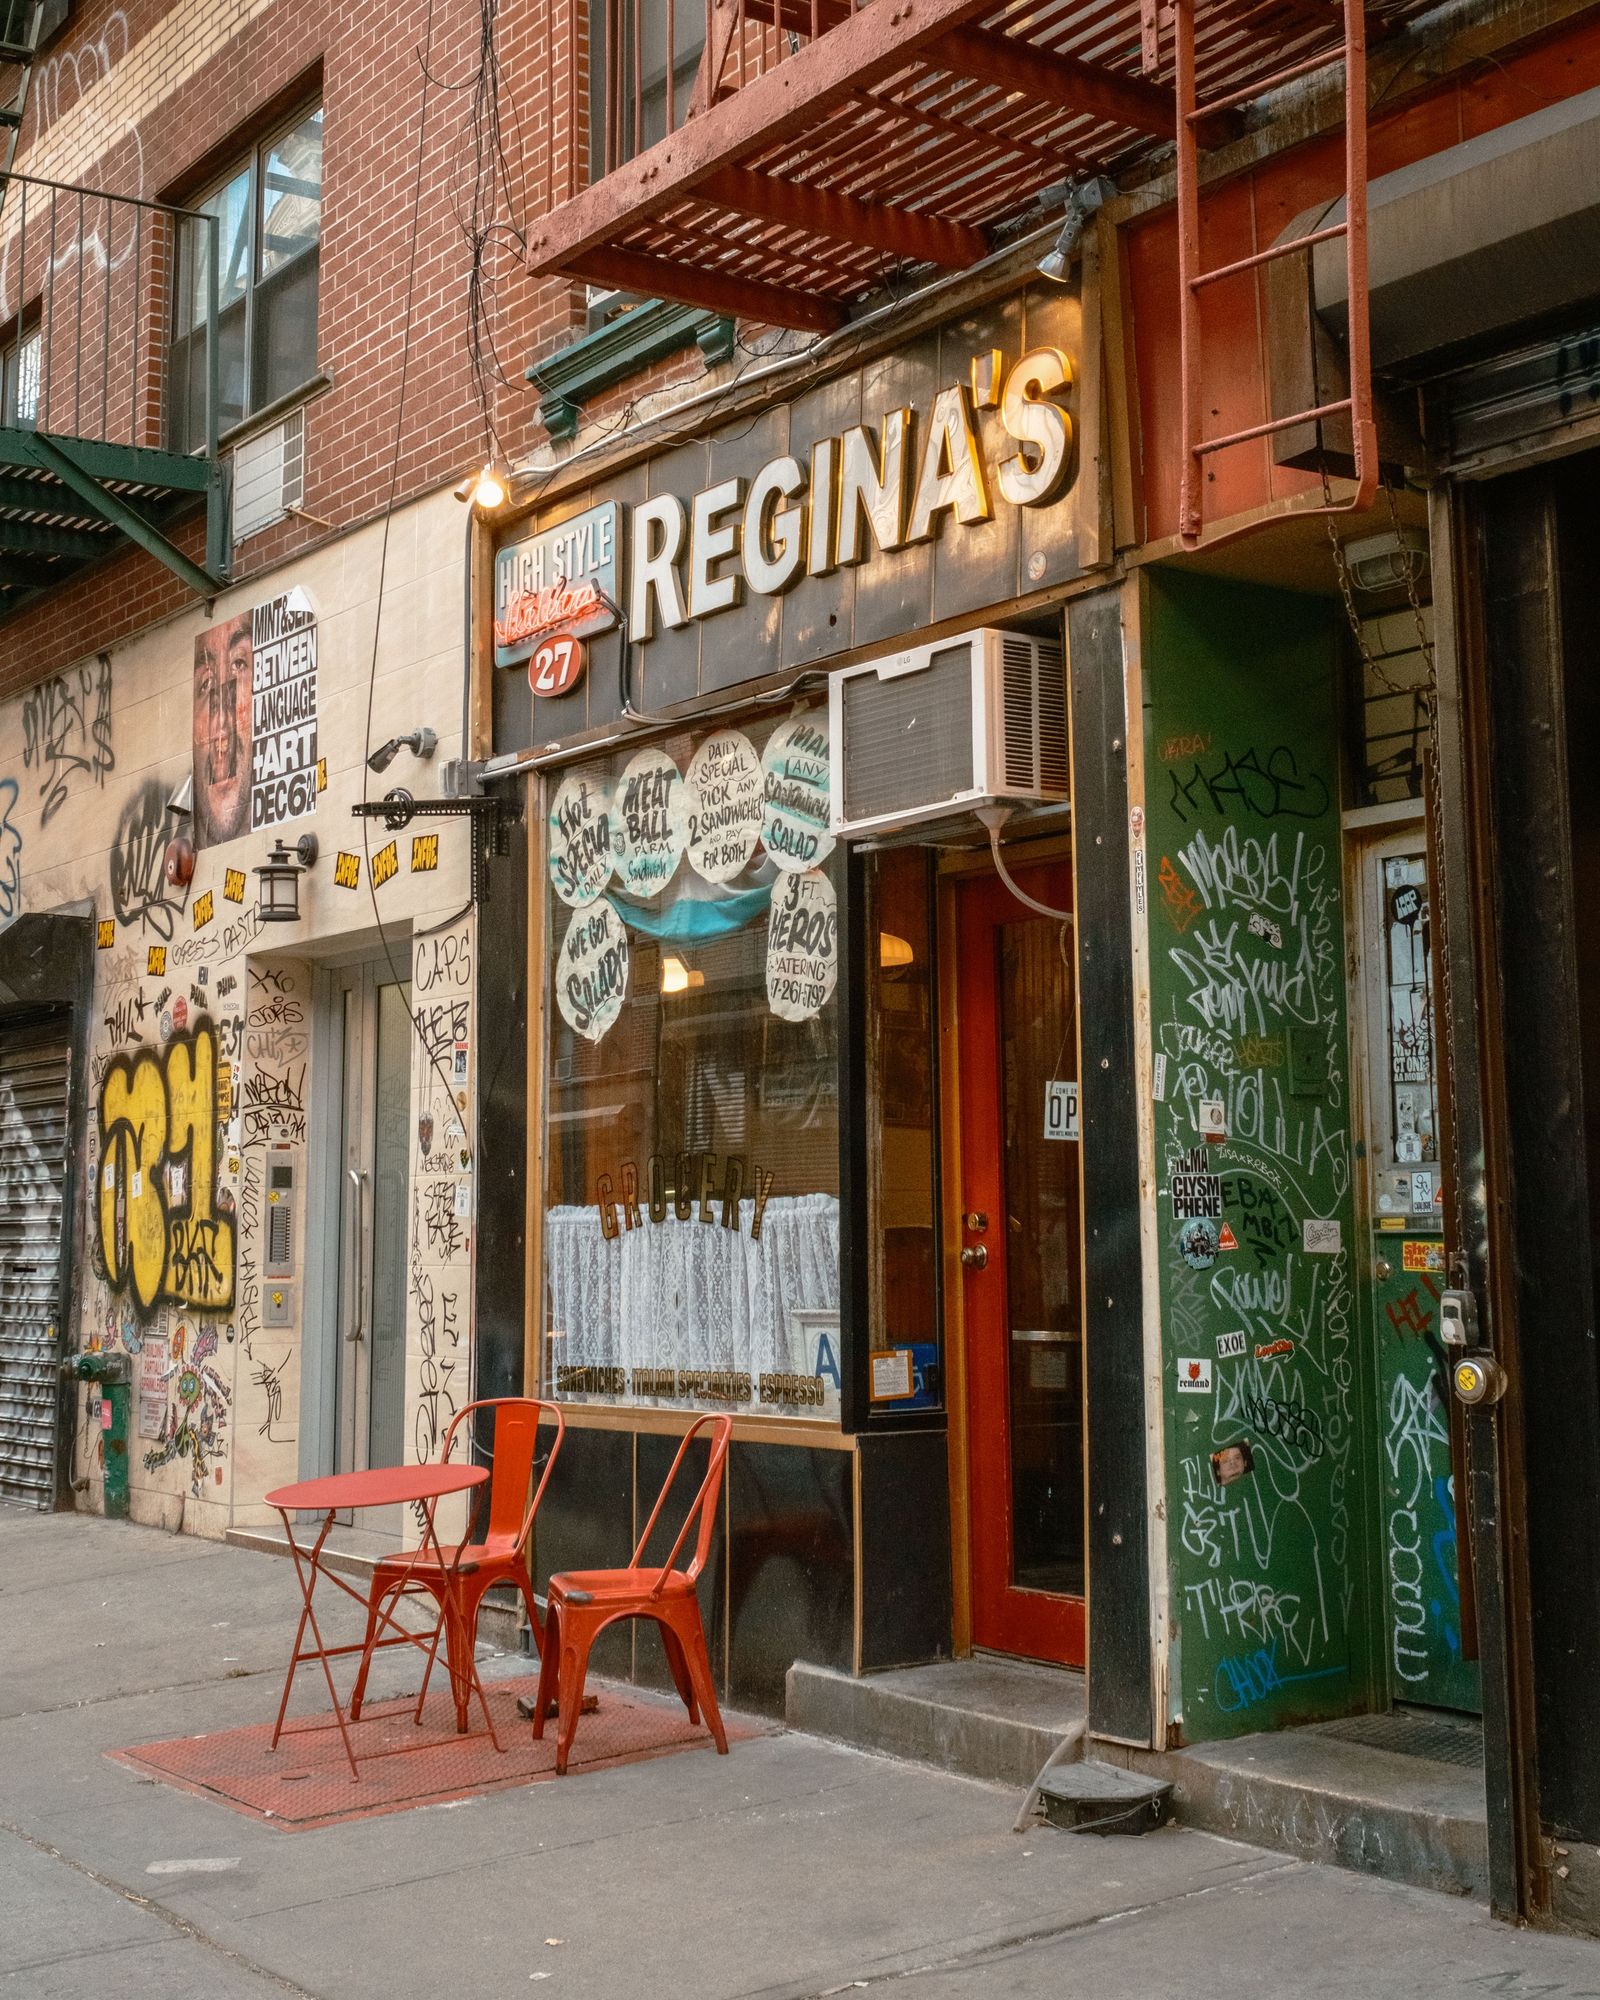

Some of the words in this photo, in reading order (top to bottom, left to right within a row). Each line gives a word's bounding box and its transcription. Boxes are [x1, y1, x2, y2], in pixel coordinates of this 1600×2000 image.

[629, 346, 1073, 643] REGINA'S
[500, 545, 547, 609] HIGH
[552, 514, 613, 584] STYLE
[253, 628, 317, 693] BETWEEN
[535, 640, 574, 690] 27
[903, 655, 911, 665] LG
[253, 675, 316, 737] LANGUAGE
[707, 740, 740, 760] DAILY
[787, 724, 830, 760] MA
[700, 760, 749, 785] SPECIAL
[792, 758, 825, 777] ANY
[622, 767, 677, 817] MEAT
[701, 781, 731, 811] PICK
[736, 778, 759, 795] ANY
[627, 808, 674, 844] BALL
[688, 815, 702, 846] 2
[701, 796, 765, 835] SANDWICHES
[726, 828, 744, 842] PAY
[769, 818, 819, 862] SALAD
[557, 812, 611, 898] SPECIA
[584, 855, 612, 895] DAILY
[703, 851, 719, 869] FOR
[721, 840, 748, 866] BOTH
[784, 873, 801, 911] 3
[567, 932, 589, 963] WE
[588, 908, 609, 944] GOT
[768, 907, 838, 958] HEROS
[415, 928, 471, 992] CAPS
[774, 957, 826, 981] ATERING
[566, 938, 628, 1031] SALADS
[1049, 1095, 1077, 1129] OP
[597, 1151, 775, 1240] GROCERY
[1172, 1175, 1220, 1197] CLYSM
[1173, 1196, 1221, 1218] PHENE
[815, 1333, 842, 1389] A
[556, 1365, 627, 1395] SANDWICHES
[631, 1367, 676, 1398] ITALIAN
[678, 1369, 752, 1402] SPECIALTIES
[759, 1372, 826, 1406] ESPRESSO
